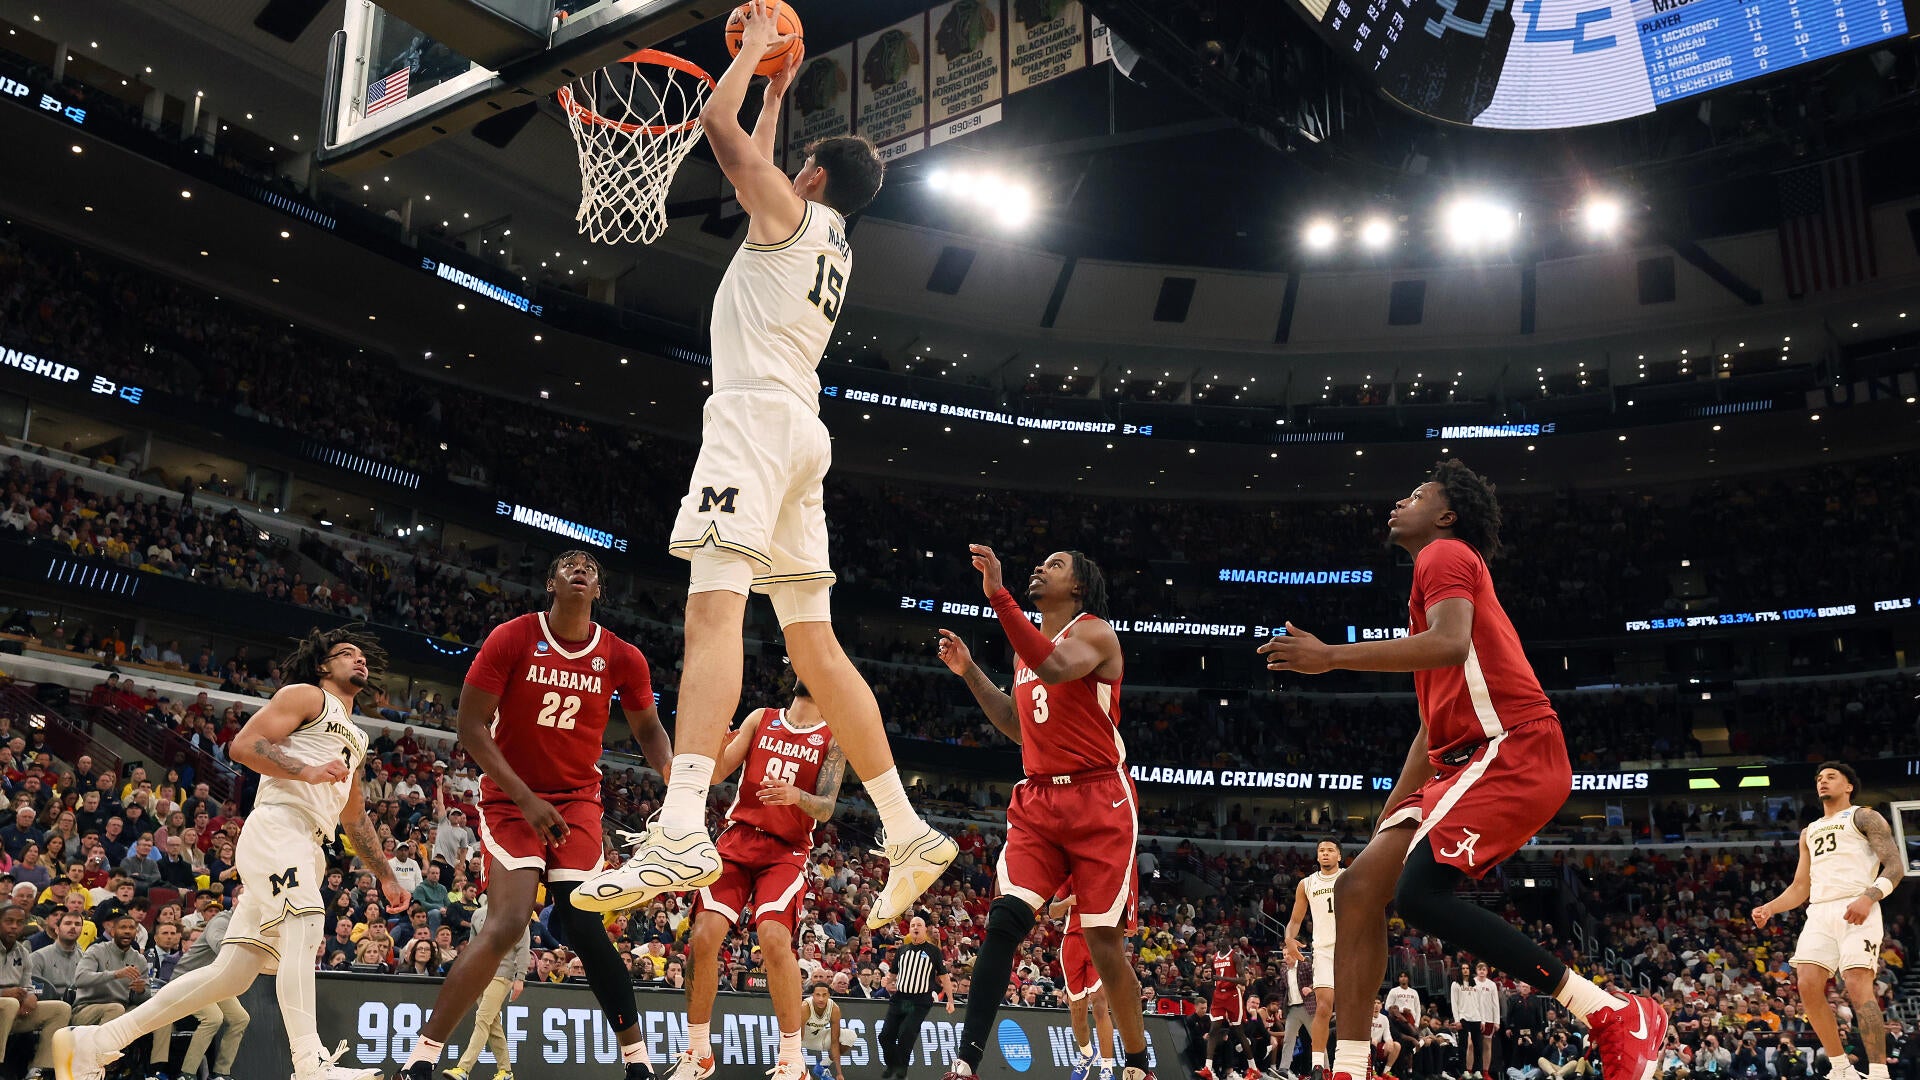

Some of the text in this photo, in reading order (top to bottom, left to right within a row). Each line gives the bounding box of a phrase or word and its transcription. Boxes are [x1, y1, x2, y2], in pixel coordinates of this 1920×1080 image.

[1337, 0, 1351, 18] REB
[1392, 11, 1405, 31] FT%
[1028, 18, 1064, 40] CHICAGO
[1358, 22, 1371, 39] AST
[1642, 13, 1681, 34] PLAYER
[1652, 5, 1761, 46] 1 MCKENNEY 14
[1016, 25, 1076, 55] BLACKHAWKS
[1654, 75, 1669, 86] 23
[1670, 55, 1732, 82] LENDEBORG
[1753, 45, 1768, 58] 22
[1794, 32, 1810, 46] 10
[1880, 9, 1889, 21] 2
[1665, 36, 1706, 57] CADEAU
[1749, 18, 1763, 32] 11
[948, 50, 983, 71] CHICAGO
[1010, 49, 1043, 68] NORRIS
[1045, 34, 1082, 56] DIVISION
[1021, 49, 1072, 76] CHAMPIONS
[1380, 44, 1389, 59] TO
[1651, 62, 1665, 75] 15
[1668, 51, 1699, 69] MARA
[933, 65, 998, 98] NORRIS DIVISION
[936, 57, 992, 86] BLACKHAWKS
[1028, 63, 1066, 85] 1992-93
[1657, 87, 1671, 99] 42
[1674, 69, 1734, 94] TSCHETTER
[864, 87, 917, 114] BLACKHAWKS
[874, 80, 907, 100] CHICAGO
[941, 81, 988, 106] CHAMPIONS
[890, 95, 923, 114] DIVISION
[794, 115, 845, 139] BLACKHAWKS
[867, 110, 912, 134] CHAMPIONS
[949, 115, 982, 135] 1990-91
[829, 226, 849, 263] MARA
[437, 262, 531, 312] MARCHMADNESS
[808, 254, 844, 323] 15
[845, 389, 1116, 433] 2026 DI MEN'S BASKETBALL CHAMPIONSHIP
[1441, 424, 1540, 439] MARCHMADNESS
[699, 486, 739, 513] M
[512, 504, 614, 549] MARCHMADNESS
[1219, 568, 1373, 585] #MARCHMADNESS
[942, 602, 980, 617] 2026
[1134, 620, 1246, 637] CHAMPIONSHIP
[1626, 620, 1650, 631] FG%
[1651, 618, 1686, 629] 35.8%
[1687, 615, 1719, 627] 3PT%
[1719, 613, 1755, 624] 33.3%
[1755, 611, 1780, 621] FT%
[1782, 608, 1816, 619] 100%
[1817, 604, 1856, 617] BONUS
[1874, 598, 1911, 611] FOULS
[1362, 627, 1390, 640] 8:31
[526, 664, 602, 694] ALABAMA
[537, 691, 581, 730] 22
[1032, 684, 1049, 724] 3
[758, 735, 820, 765] ALABAMA
[1052, 775, 1071, 785] RTR
[1130, 765, 1392, 790] ALABAMA CRIMSON TIDE VS
[1814, 832, 1837, 857] 23
[269, 867, 299, 896] M
[1326, 897, 1333, 913] 1
[1863, 939, 1877, 956] M
[753, 978, 767, 987] POSS
